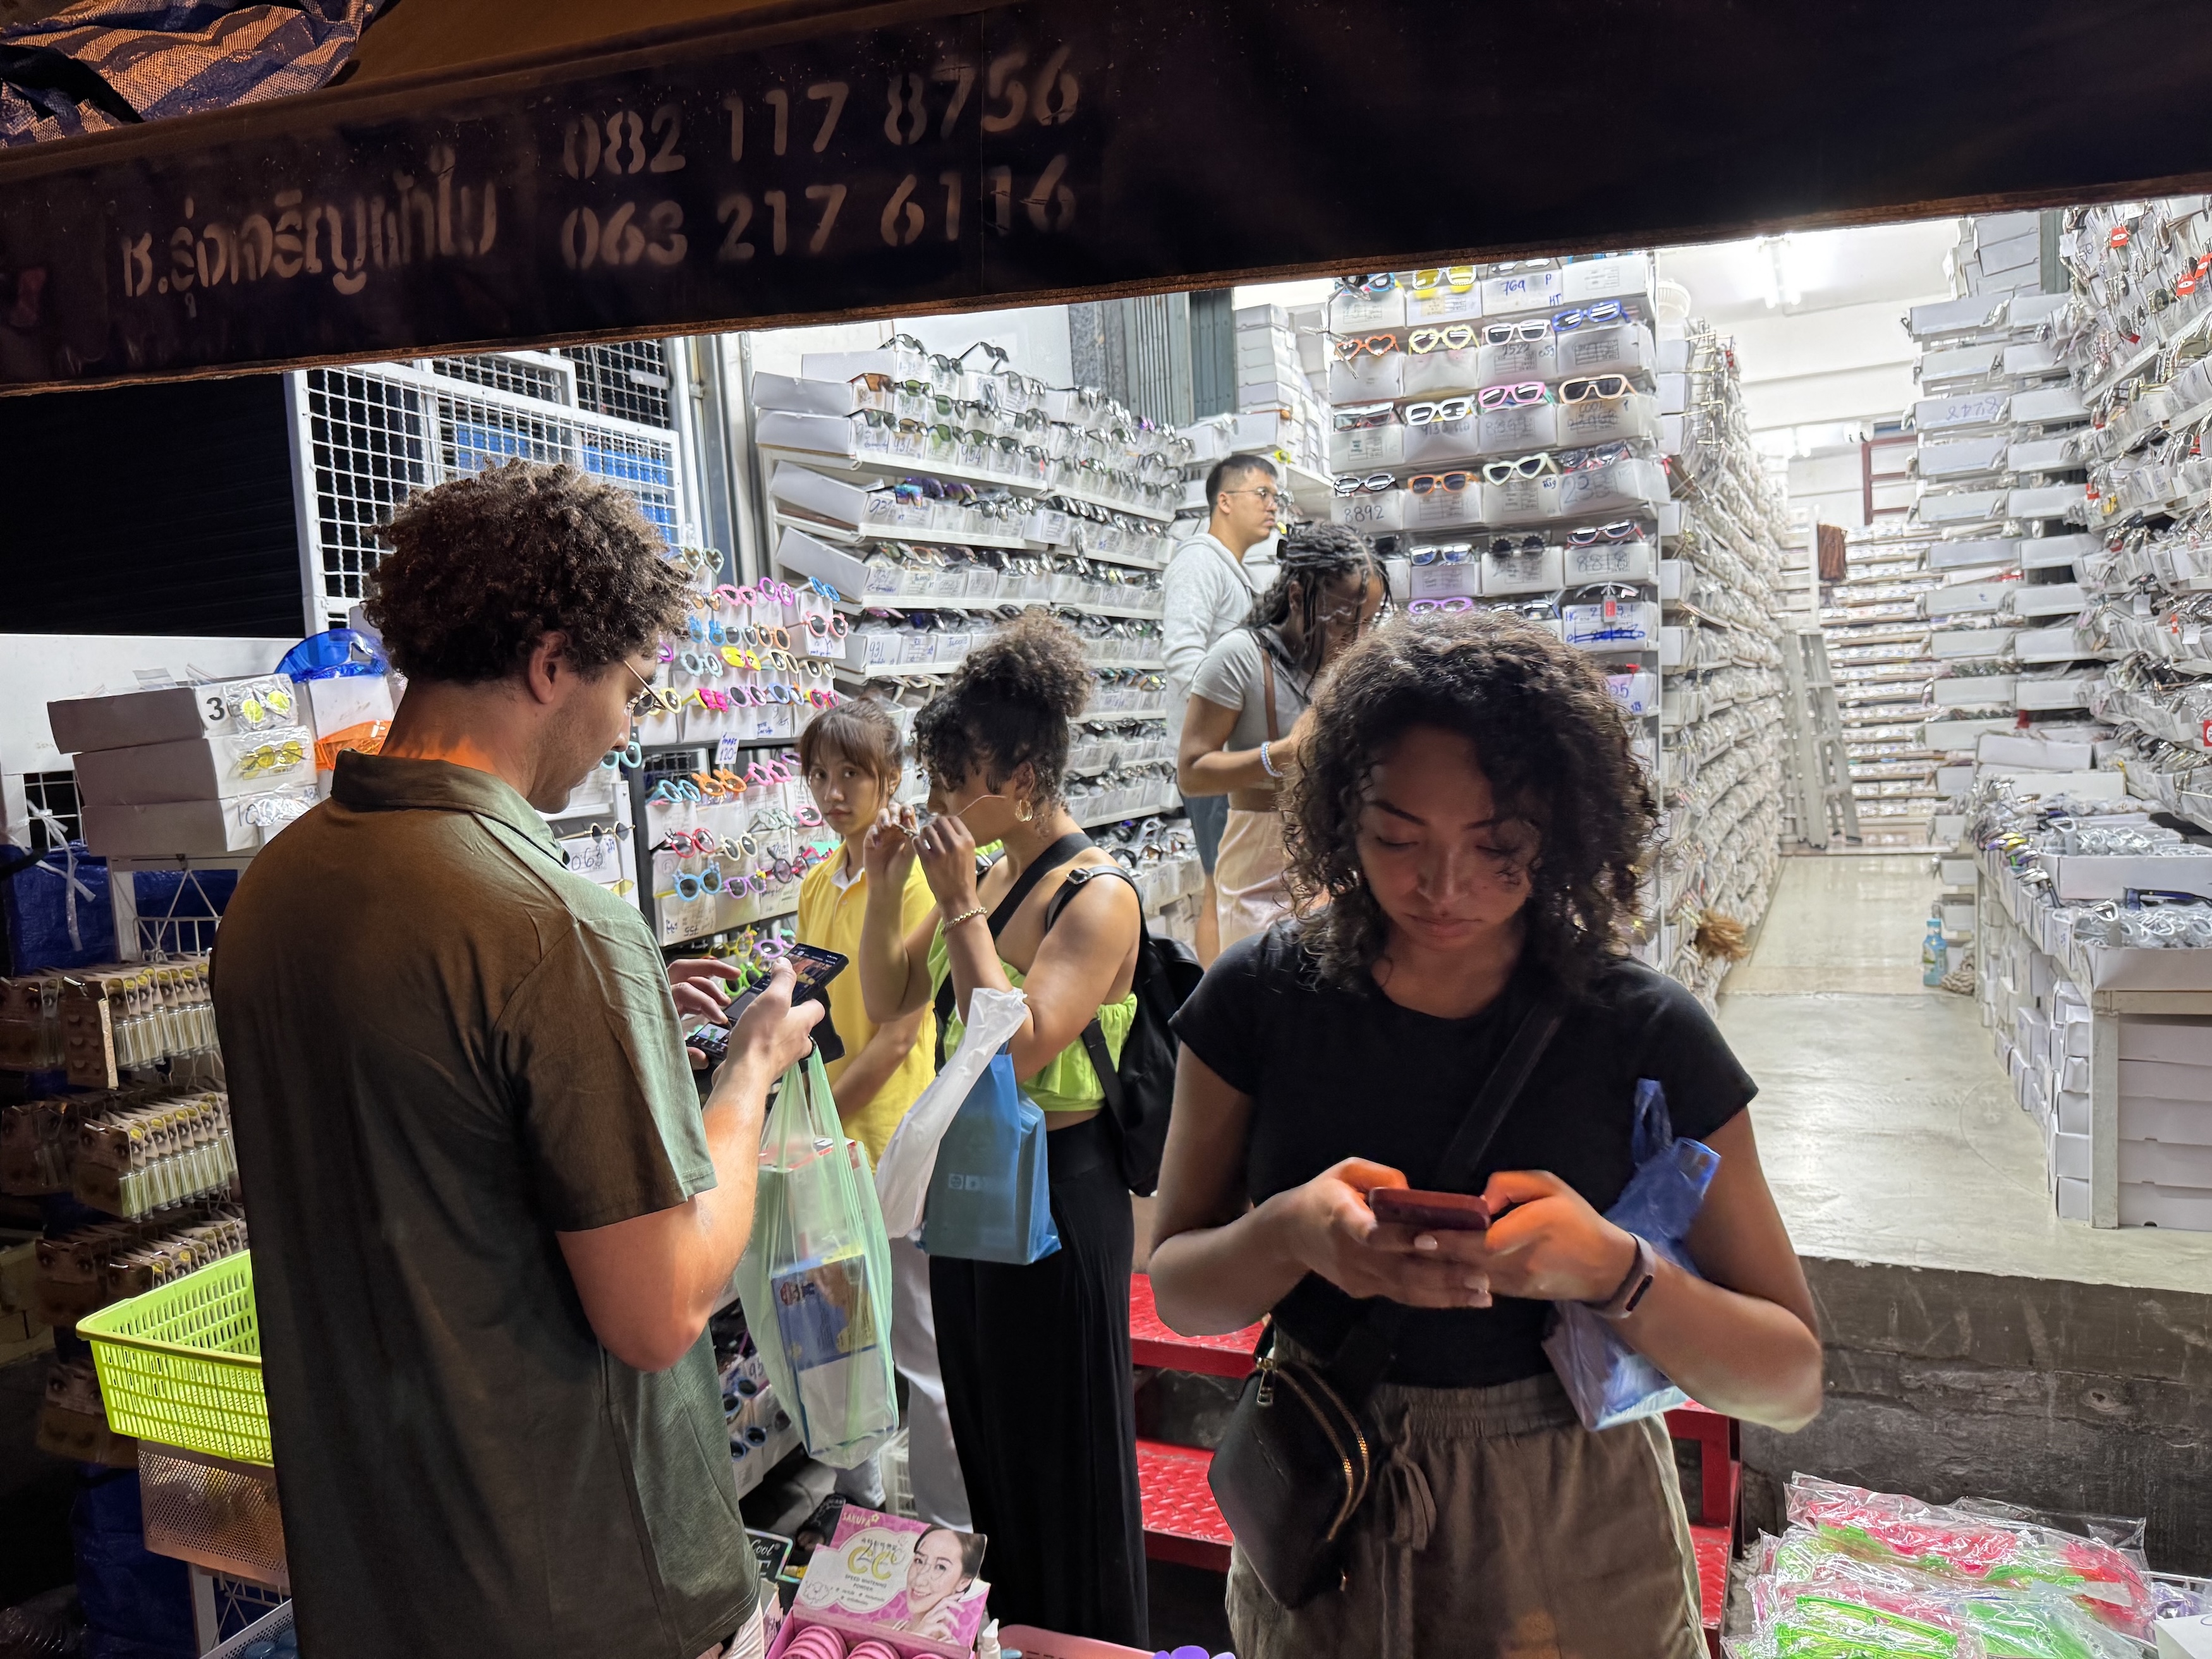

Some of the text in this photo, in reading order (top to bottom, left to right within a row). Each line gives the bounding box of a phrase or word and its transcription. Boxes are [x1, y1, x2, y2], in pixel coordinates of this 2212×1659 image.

[563, 45, 1079, 179] 082 117 8756
[561, 154, 1077, 270] 063 217 6116
[1344, 505, 1385, 523] 8892
[870, 642, 884, 659] 931
[207, 697, 225, 720] 3
